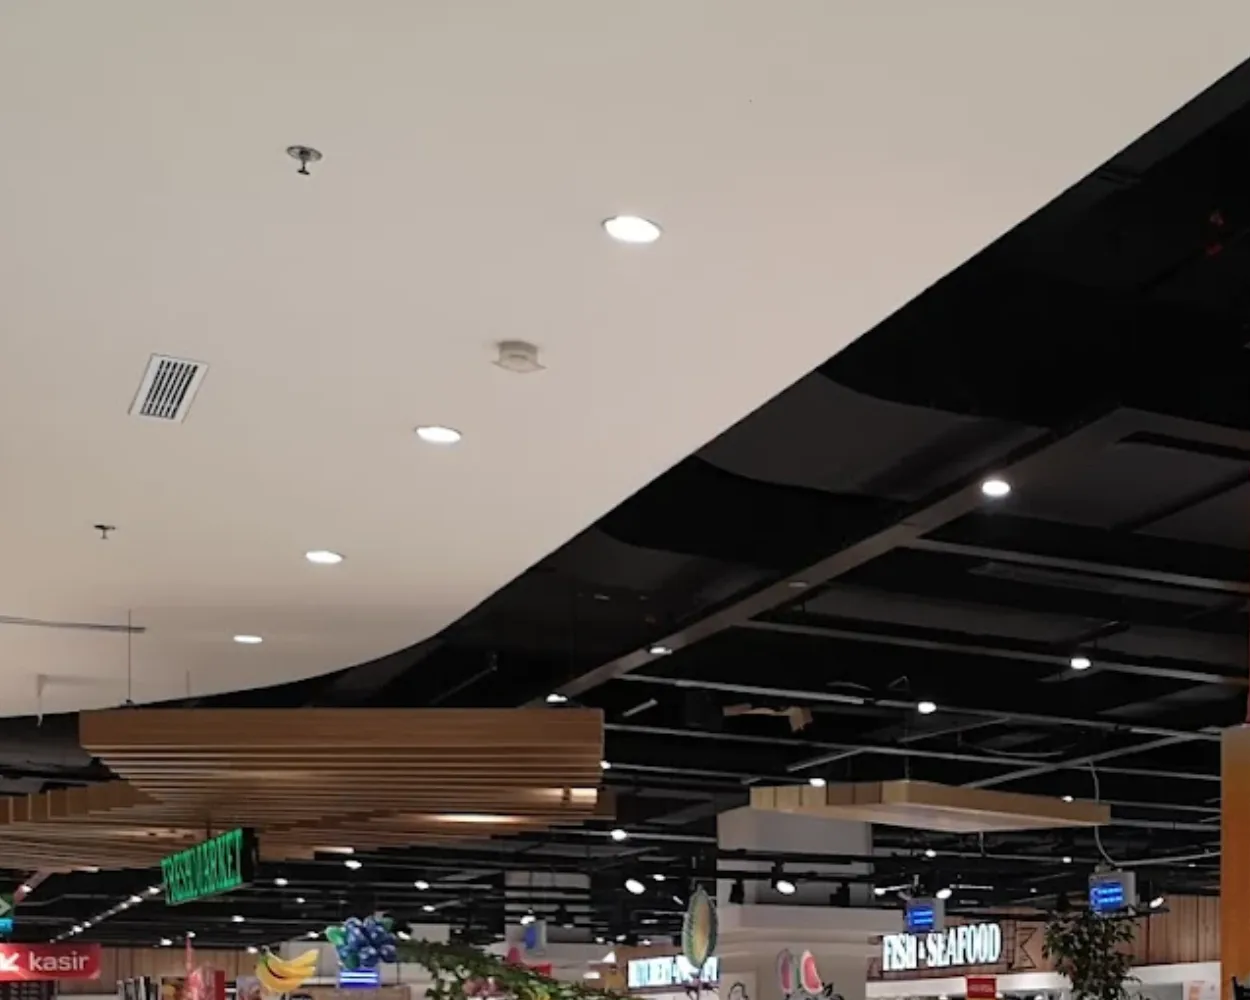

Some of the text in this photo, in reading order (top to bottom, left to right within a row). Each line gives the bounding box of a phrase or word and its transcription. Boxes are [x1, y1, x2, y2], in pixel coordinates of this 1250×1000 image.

[29, 951, 90, 971] kasir
[883, 932, 917, 971] FISH
[926, 923, 1001, 968] SEAFOOD
